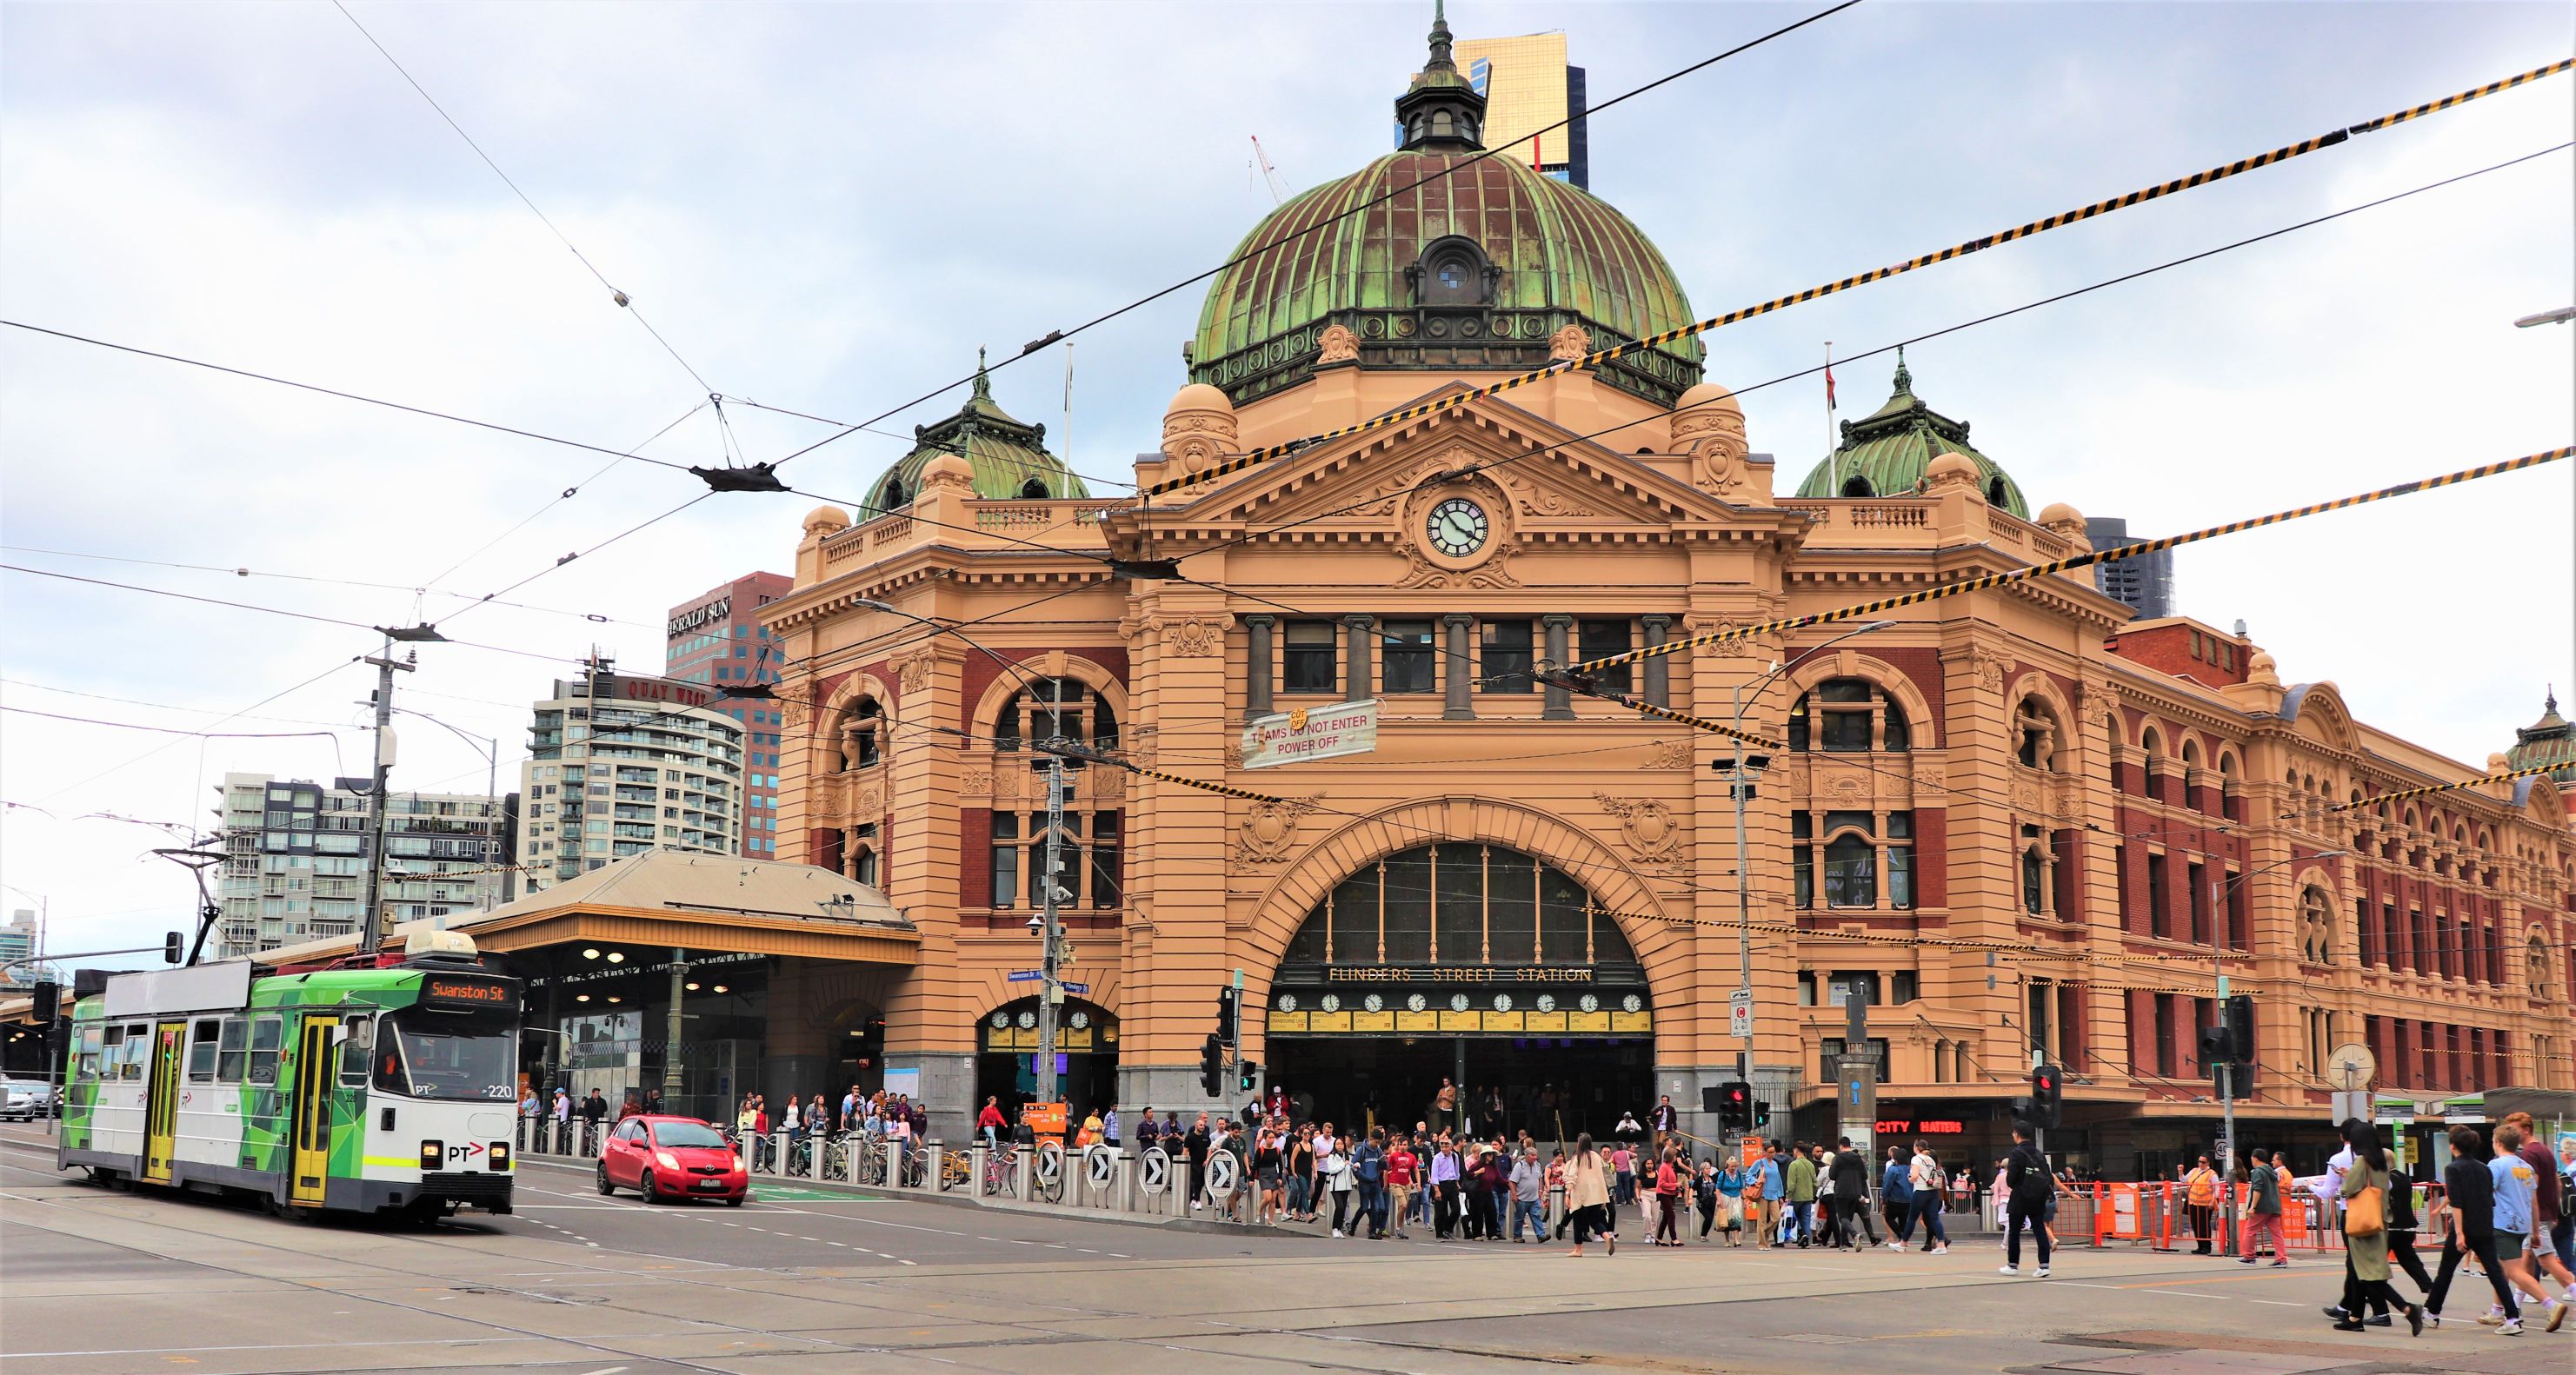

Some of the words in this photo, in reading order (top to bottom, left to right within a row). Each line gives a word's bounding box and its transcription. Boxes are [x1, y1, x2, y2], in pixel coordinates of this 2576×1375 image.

[668, 609, 705, 635] HERALD
[709, 599, 729, 620] SUN
[628, 681, 669, 699] QUAY
[676, 688, 706, 707] WEST
[1291, 710, 1305, 719] CUT
[1251, 727, 1287, 743] TAMS
[1308, 721, 1329, 735] NOT
[1332, 715, 1368, 731] ENTER
[1291, 719, 1305, 727] OFF
[1278, 740, 1315, 754] POWER
[1318, 735, 1340, 749] OFF
[1329, 968, 1411, 981] FLINDERS
[1433, 968, 1496, 981] STREET
[1515, 968, 1593, 982] STATION
[432, 981, 488, 1000] Swanston
[489, 986, 504, 1000] St
[488, 1085, 512, 1098] 220
[1874, 1120, 1910, 1133] CITY
[1920, 1120, 1962, 1133] HATTERS
